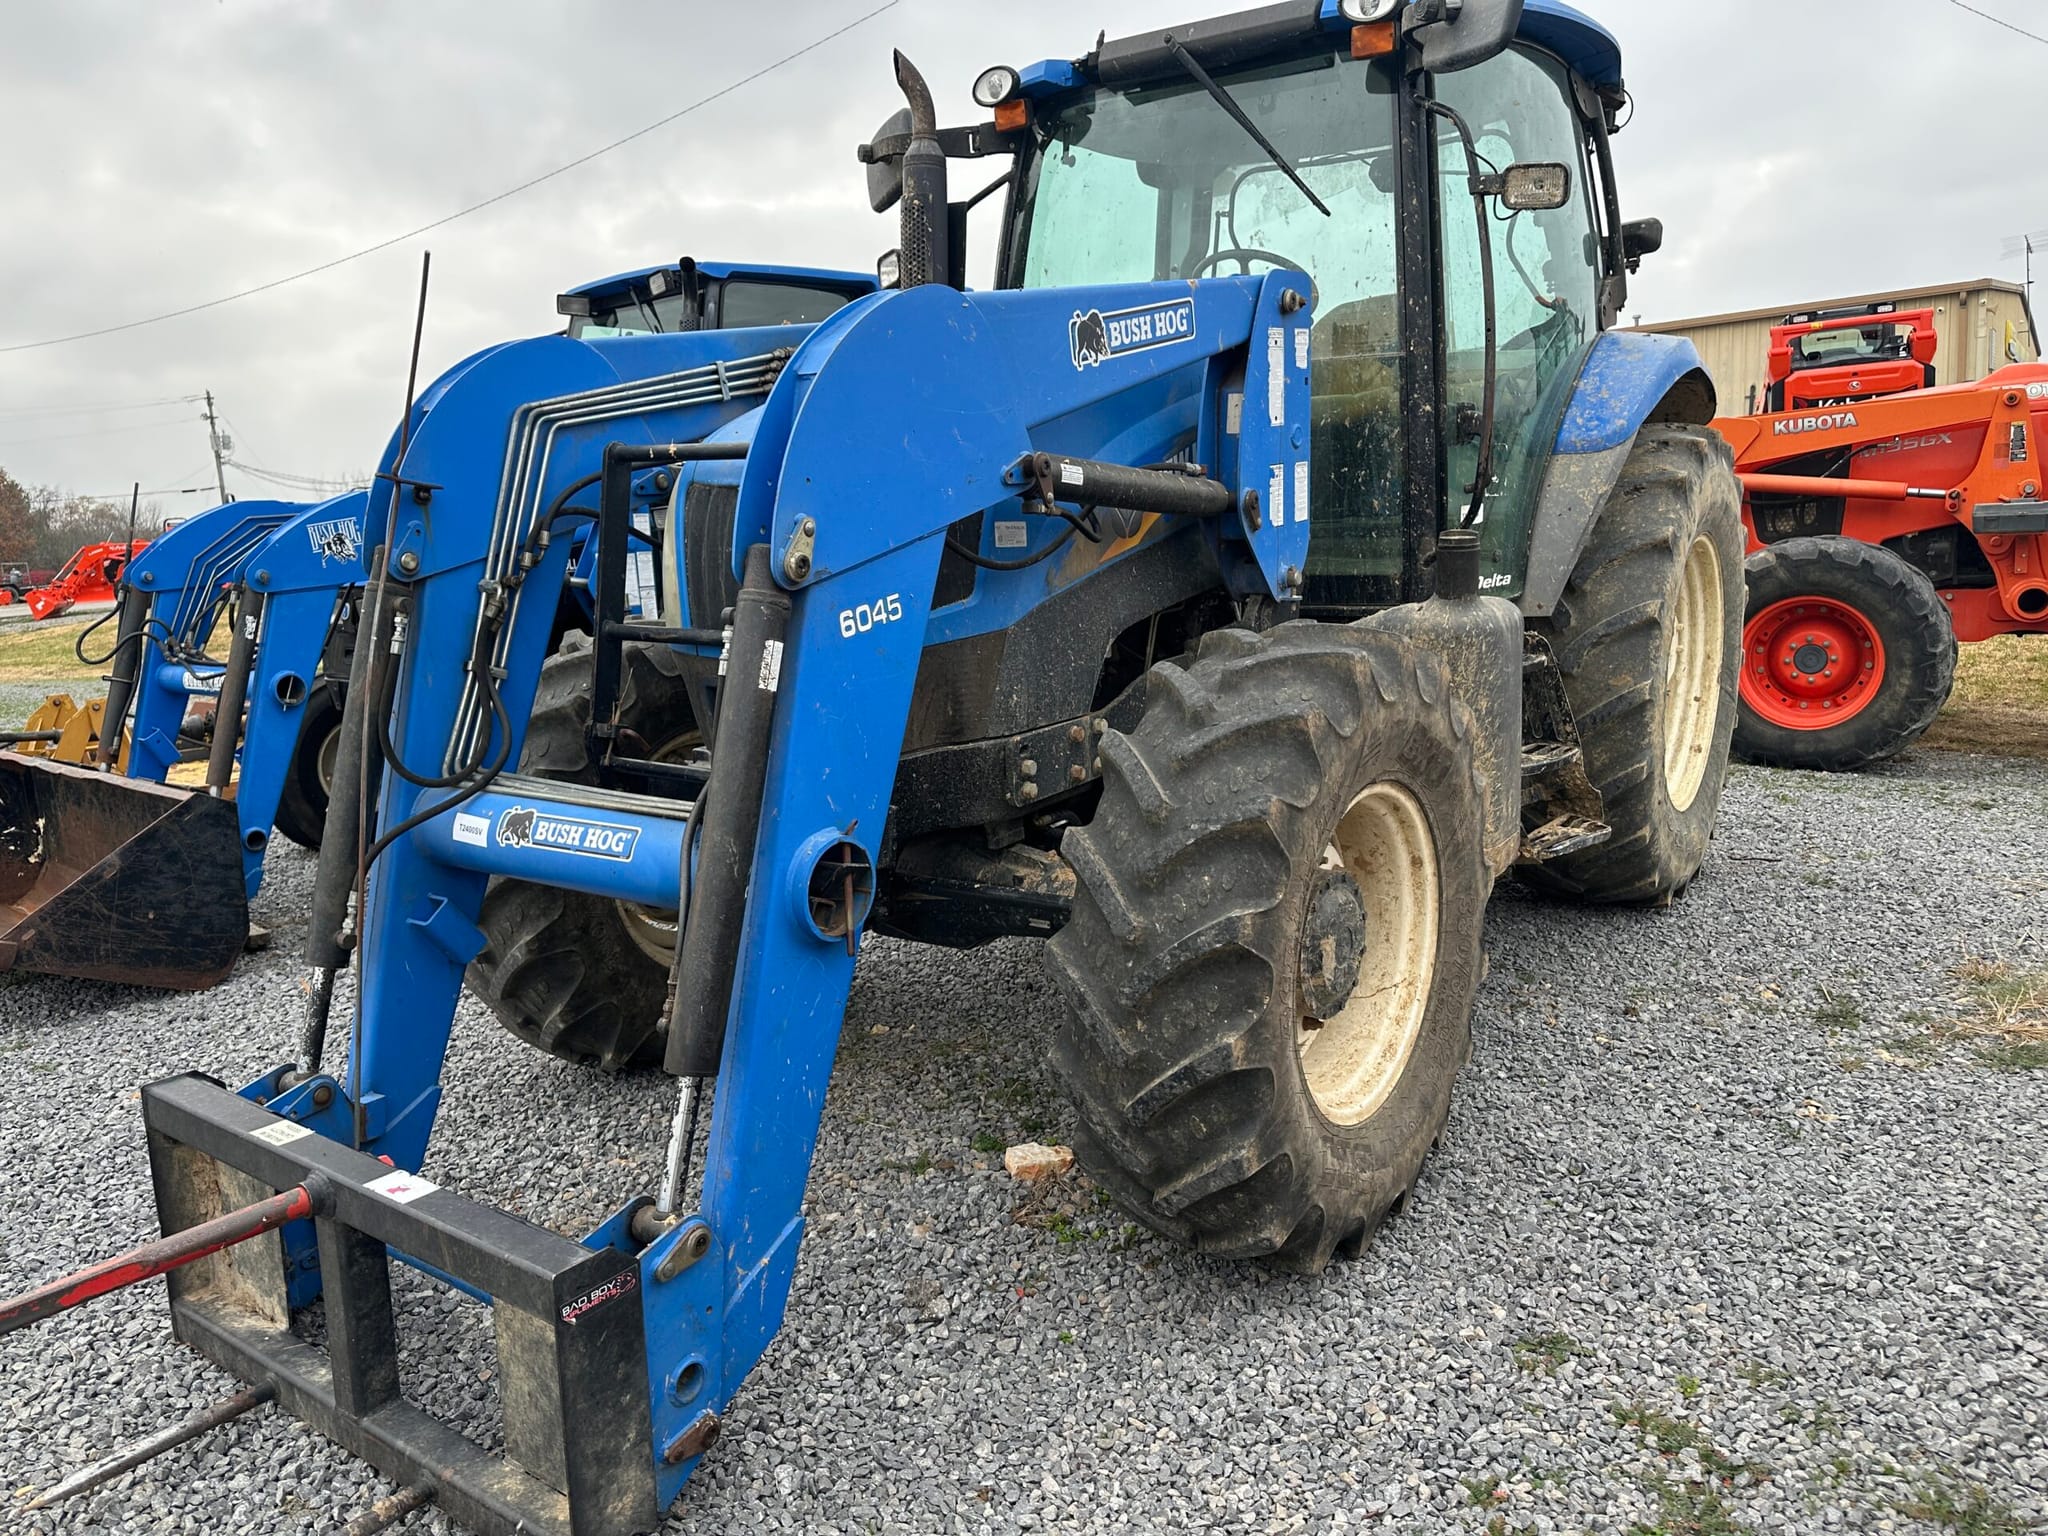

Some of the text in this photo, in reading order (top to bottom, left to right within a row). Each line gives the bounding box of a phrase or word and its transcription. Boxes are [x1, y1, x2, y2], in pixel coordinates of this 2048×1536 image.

[1109, 308, 1189, 347] BUSH HOG
[1773, 412, 1858, 435] KUBOTA
[839, 592, 902, 638] 6045
[534, 820, 629, 853] BUSH HOG
[562, 1280, 616, 1317] BAD BOY
[564, 1287, 618, 1320] PLEMENTS
